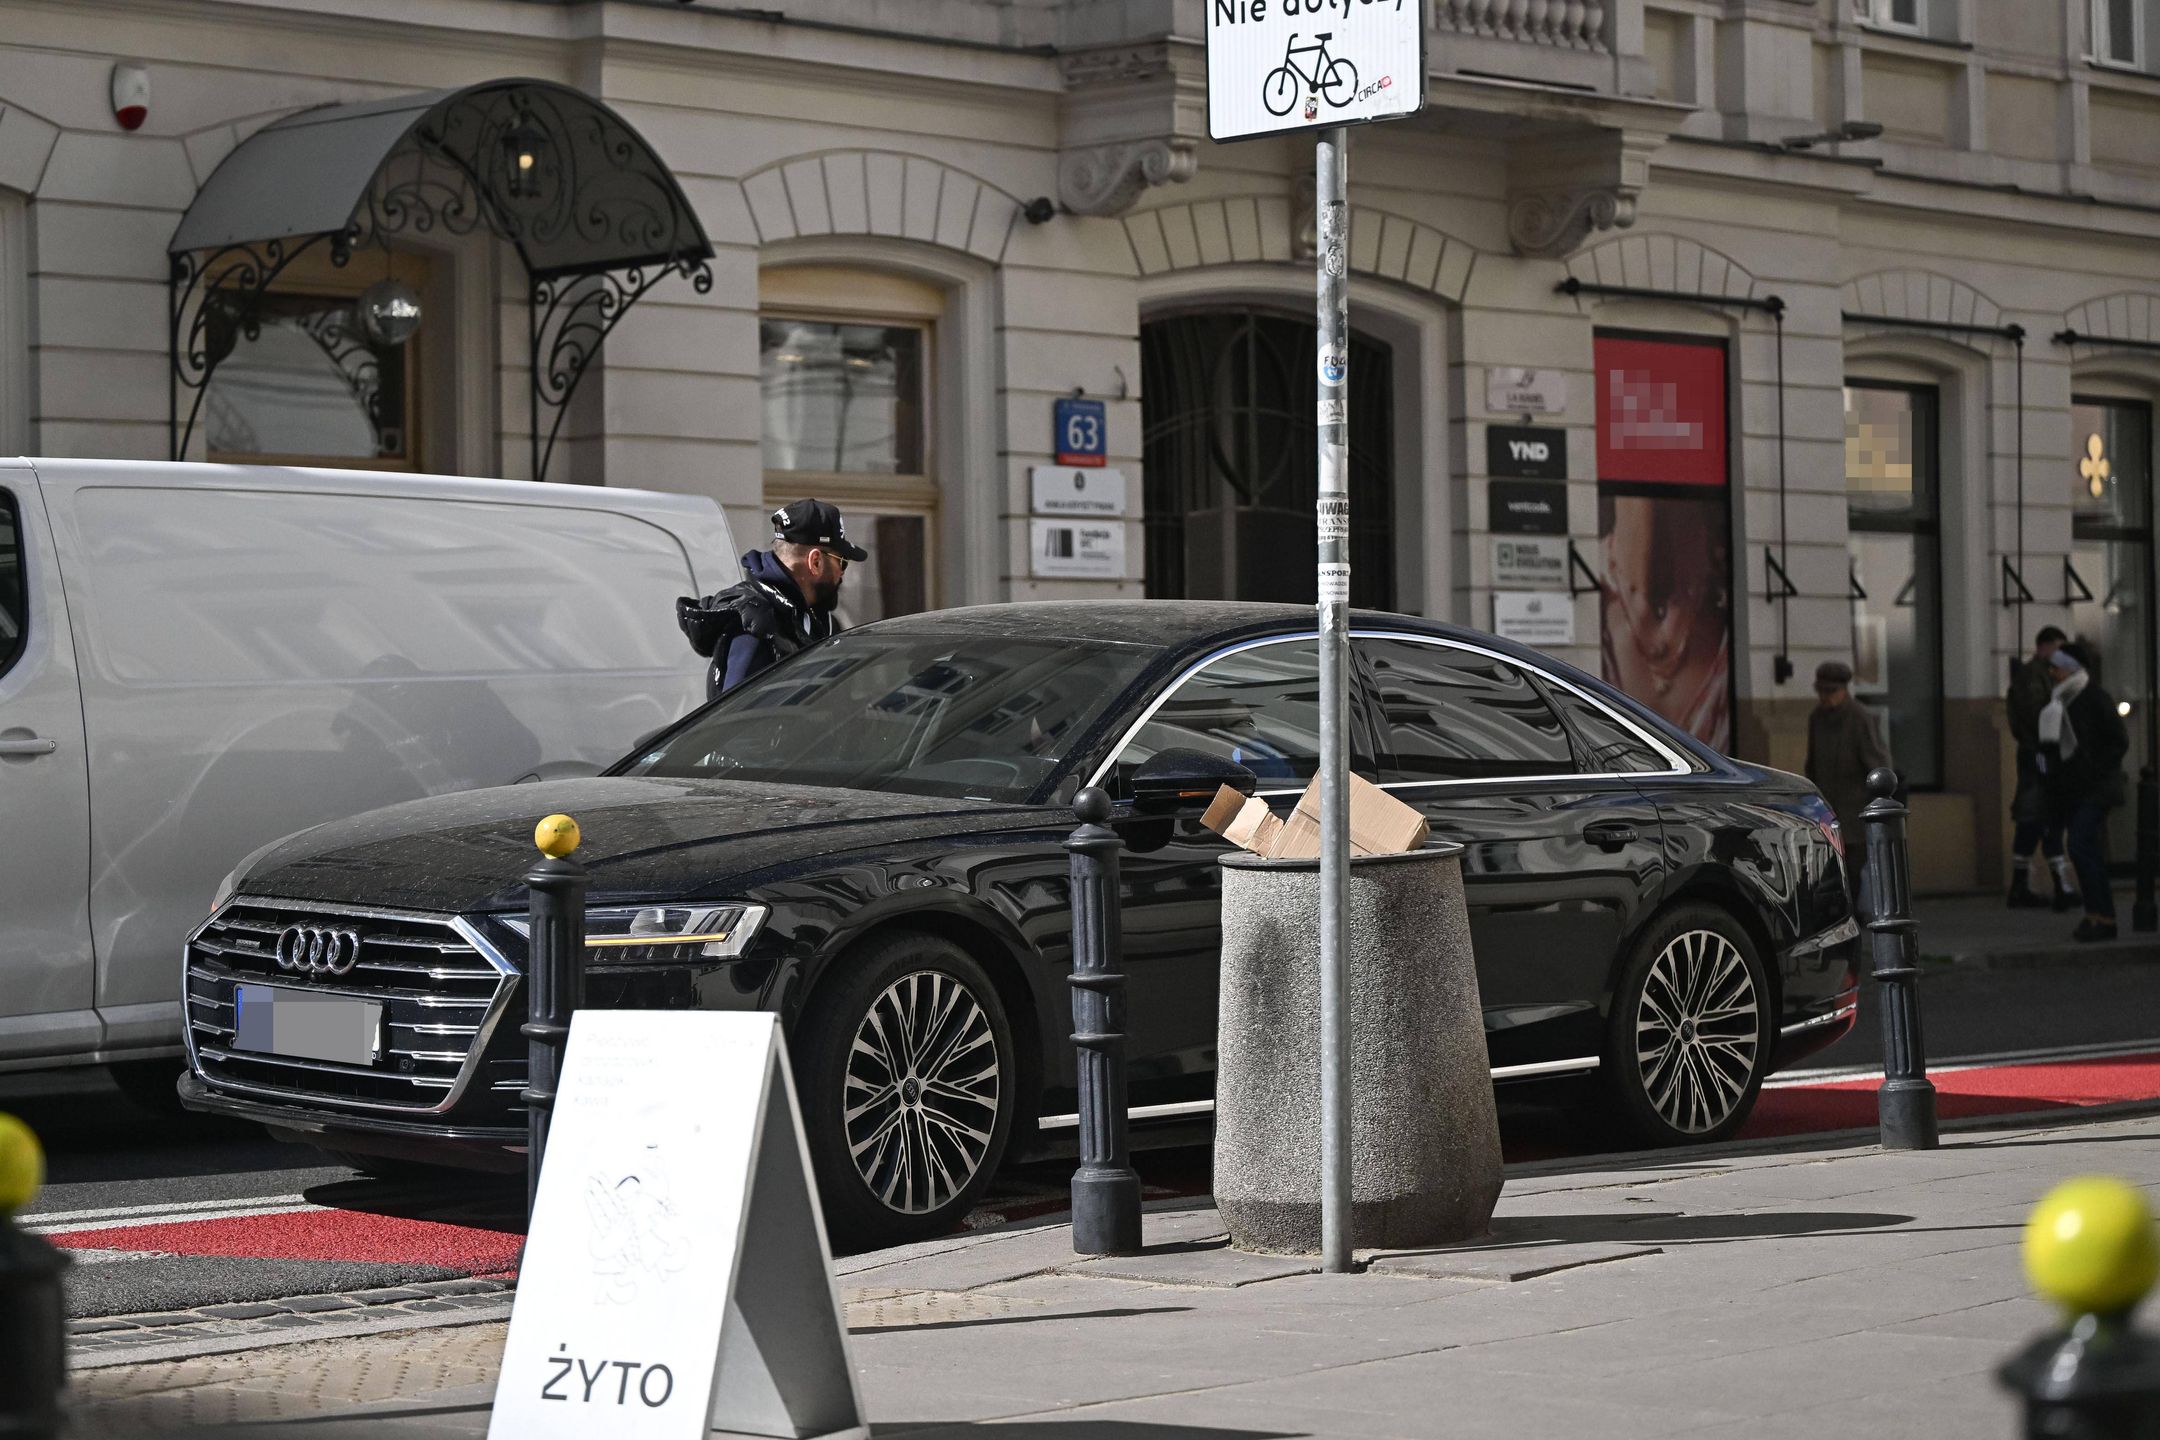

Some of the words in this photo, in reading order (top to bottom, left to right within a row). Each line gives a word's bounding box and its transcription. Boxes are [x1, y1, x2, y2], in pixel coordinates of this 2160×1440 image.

[1068, 415, 1098, 450] 63
[1509, 440, 1549, 462] YND
[541, 1343, 673, 1408] ŻYTO
